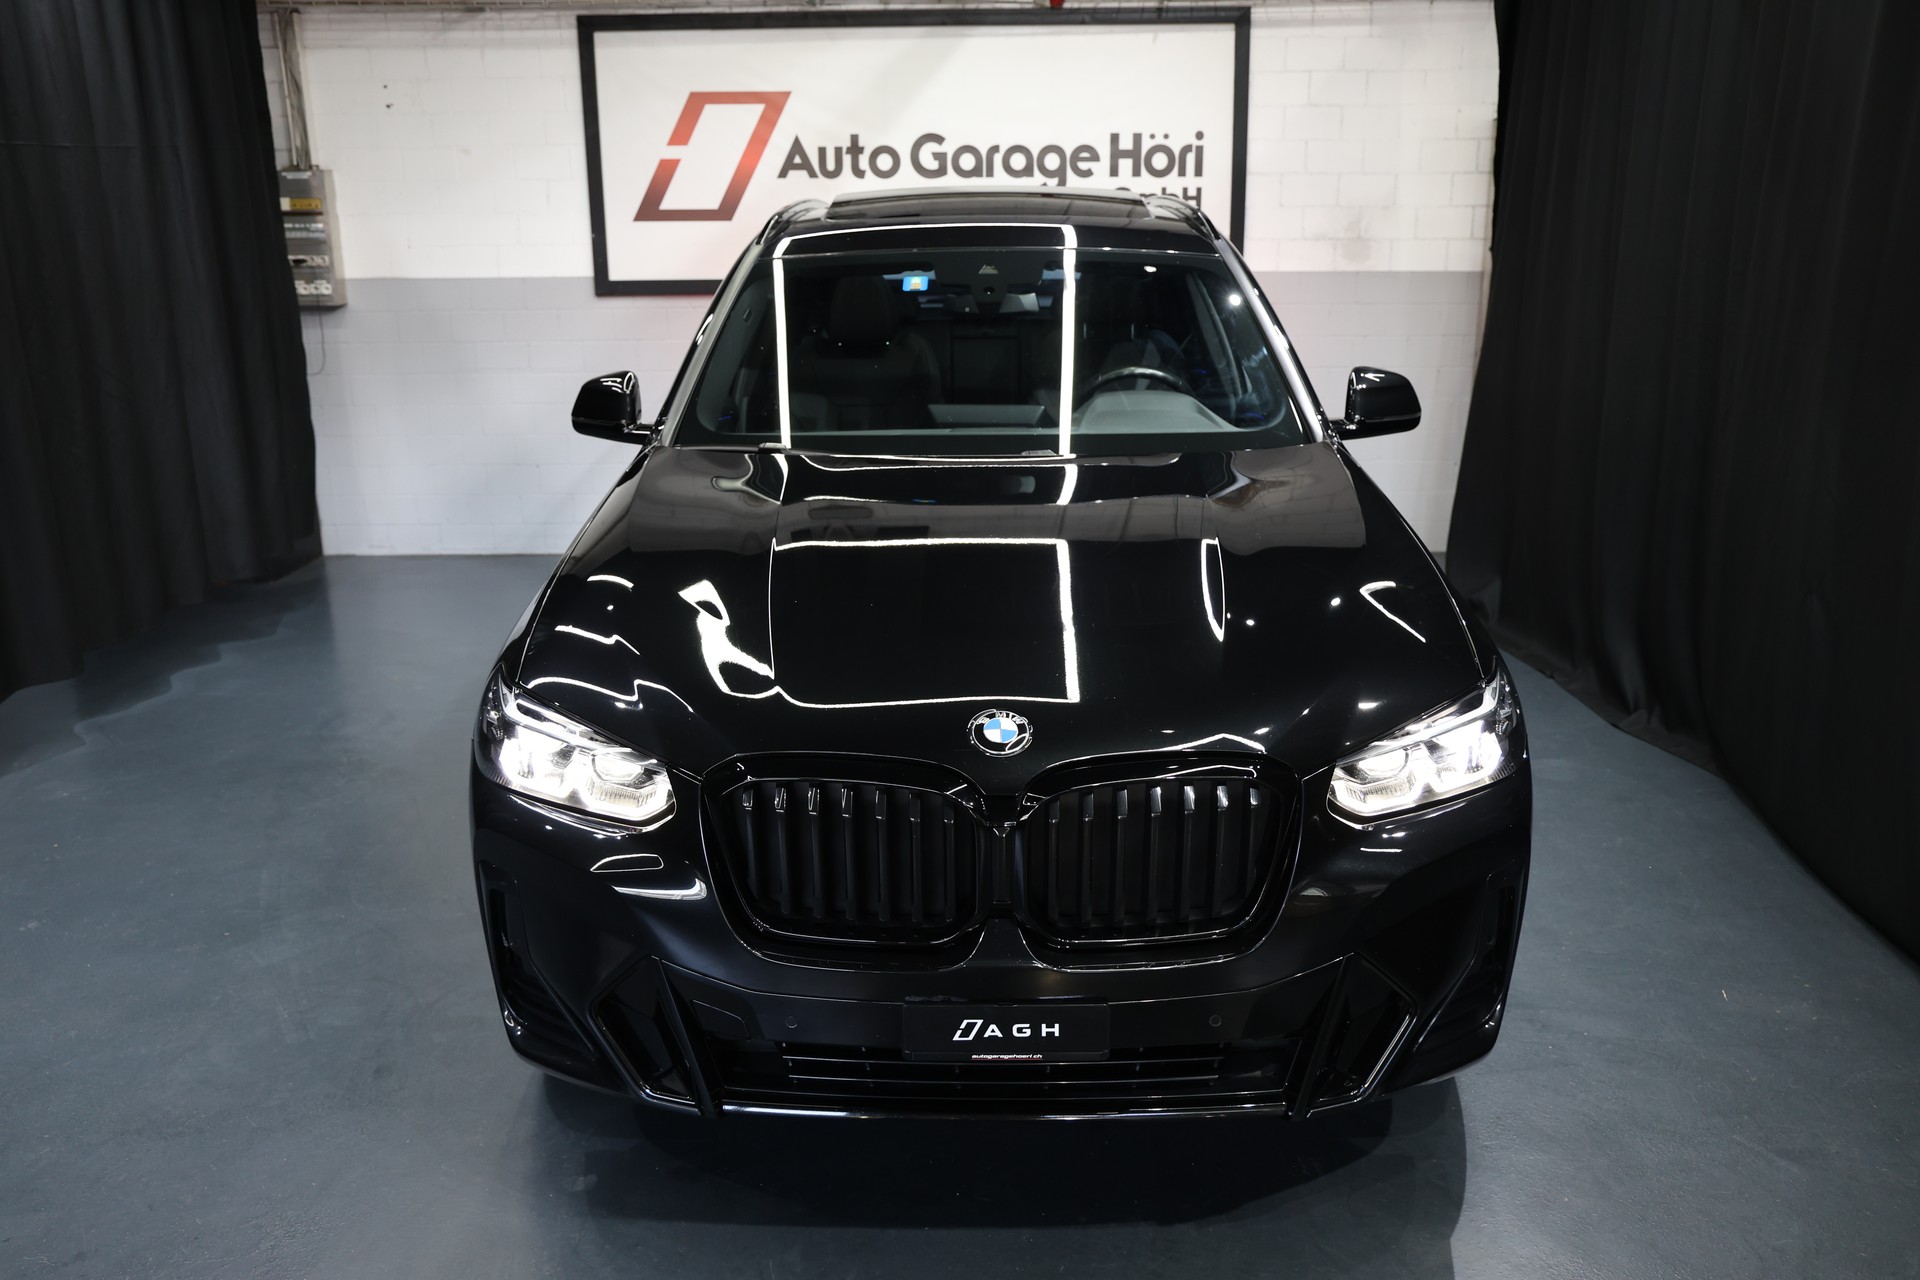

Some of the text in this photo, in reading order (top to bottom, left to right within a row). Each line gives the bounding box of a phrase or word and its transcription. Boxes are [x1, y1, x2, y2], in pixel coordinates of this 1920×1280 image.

[777, 131, 1204, 187] Auto Garage Höri
[976, 711, 1025, 725] BMW
[983, 1023, 1060, 1038] AGH
